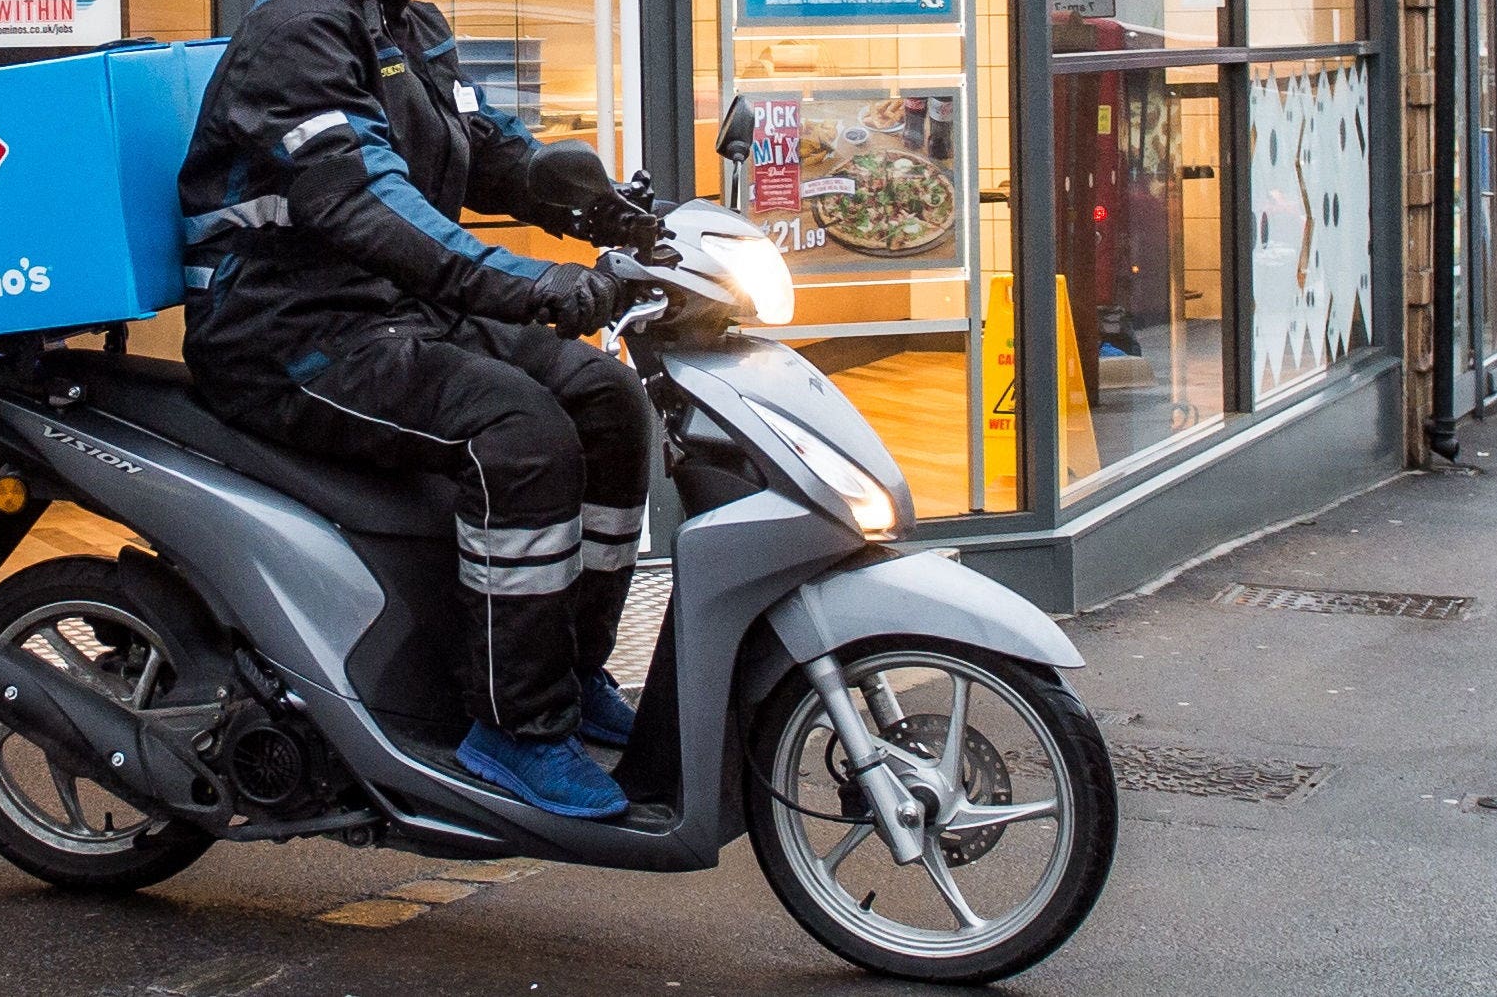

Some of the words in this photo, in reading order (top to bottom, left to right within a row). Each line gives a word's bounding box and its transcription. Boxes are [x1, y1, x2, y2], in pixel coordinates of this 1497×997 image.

[754, 102, 798, 135] PICK
[989, 418, 1011, 430] WET
[43, 423, 143, 474] VISION
